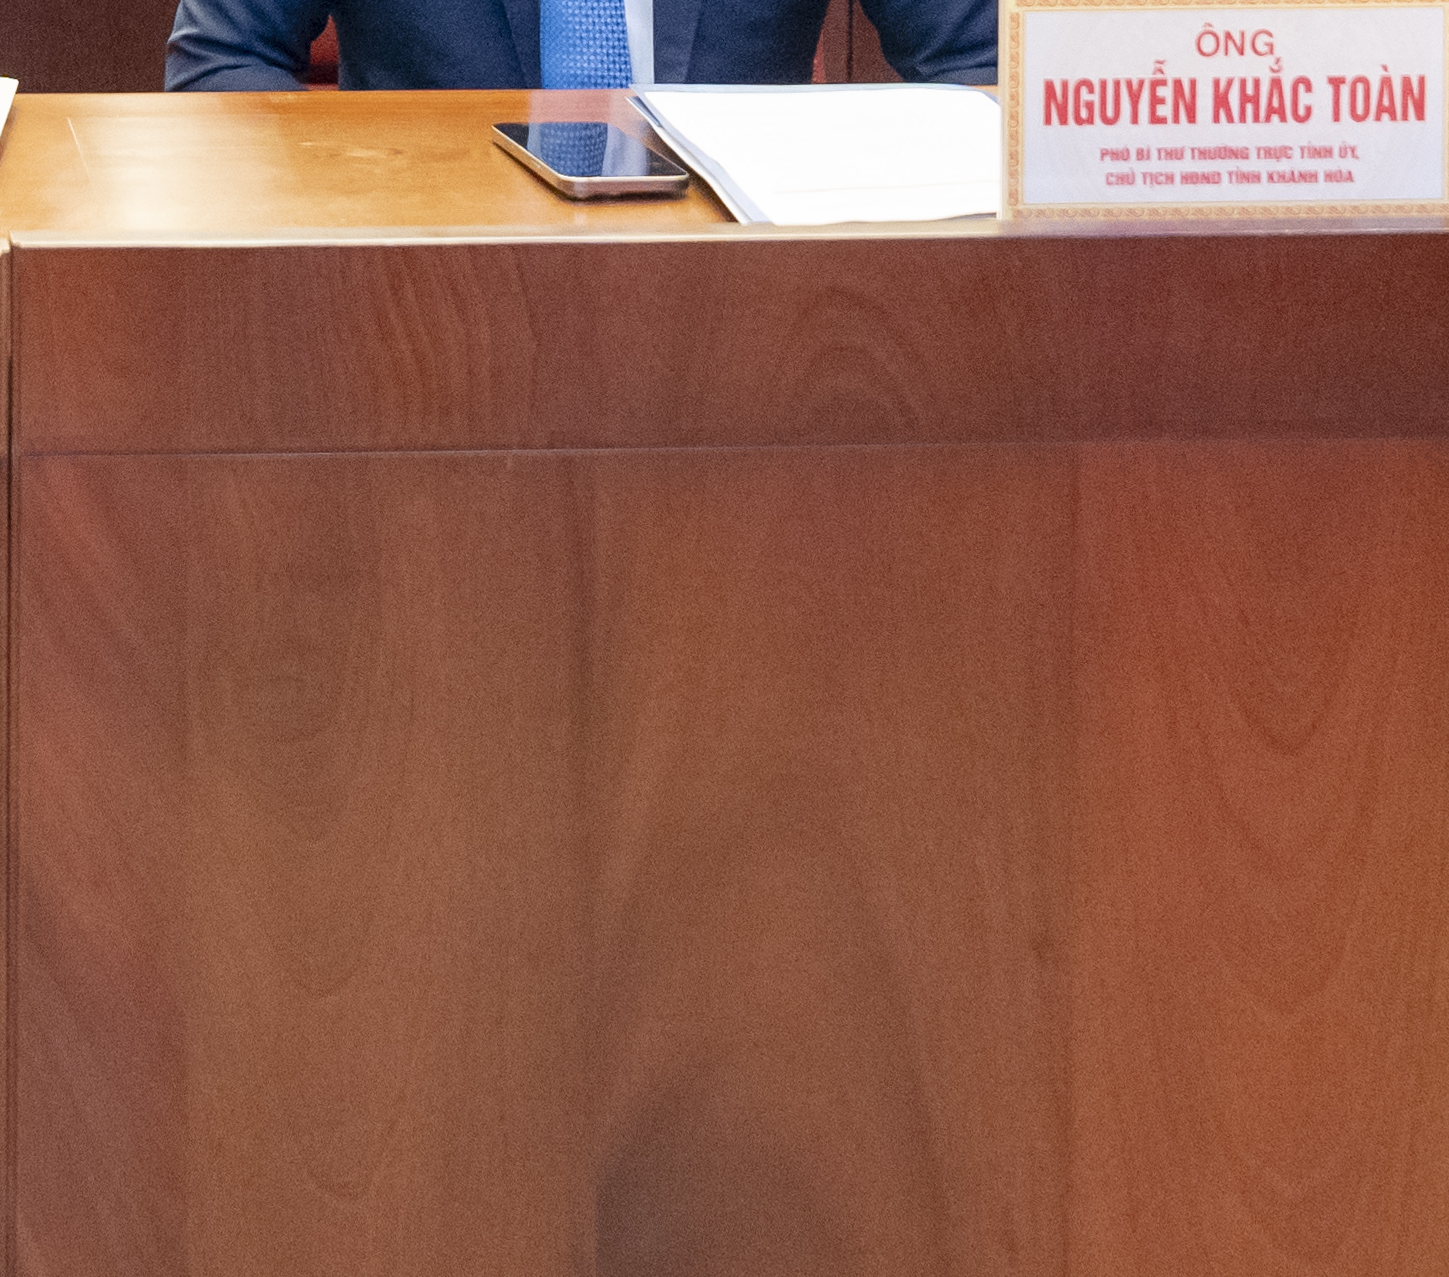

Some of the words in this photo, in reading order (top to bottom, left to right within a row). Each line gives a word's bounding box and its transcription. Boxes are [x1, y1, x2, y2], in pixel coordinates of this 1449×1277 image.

[1195, 23, 1276, 60] ÔNG
[1043, 60, 1197, 127] NGUYỄN
[1213, 58, 1313, 125] KHẮC
[1327, 64, 1426, 124] TOÀN
[1099, 146, 1131, 162] PHÓ
[1106, 168, 1135, 186] CHỦ
[1142, 171, 1174, 187] TỊCH
